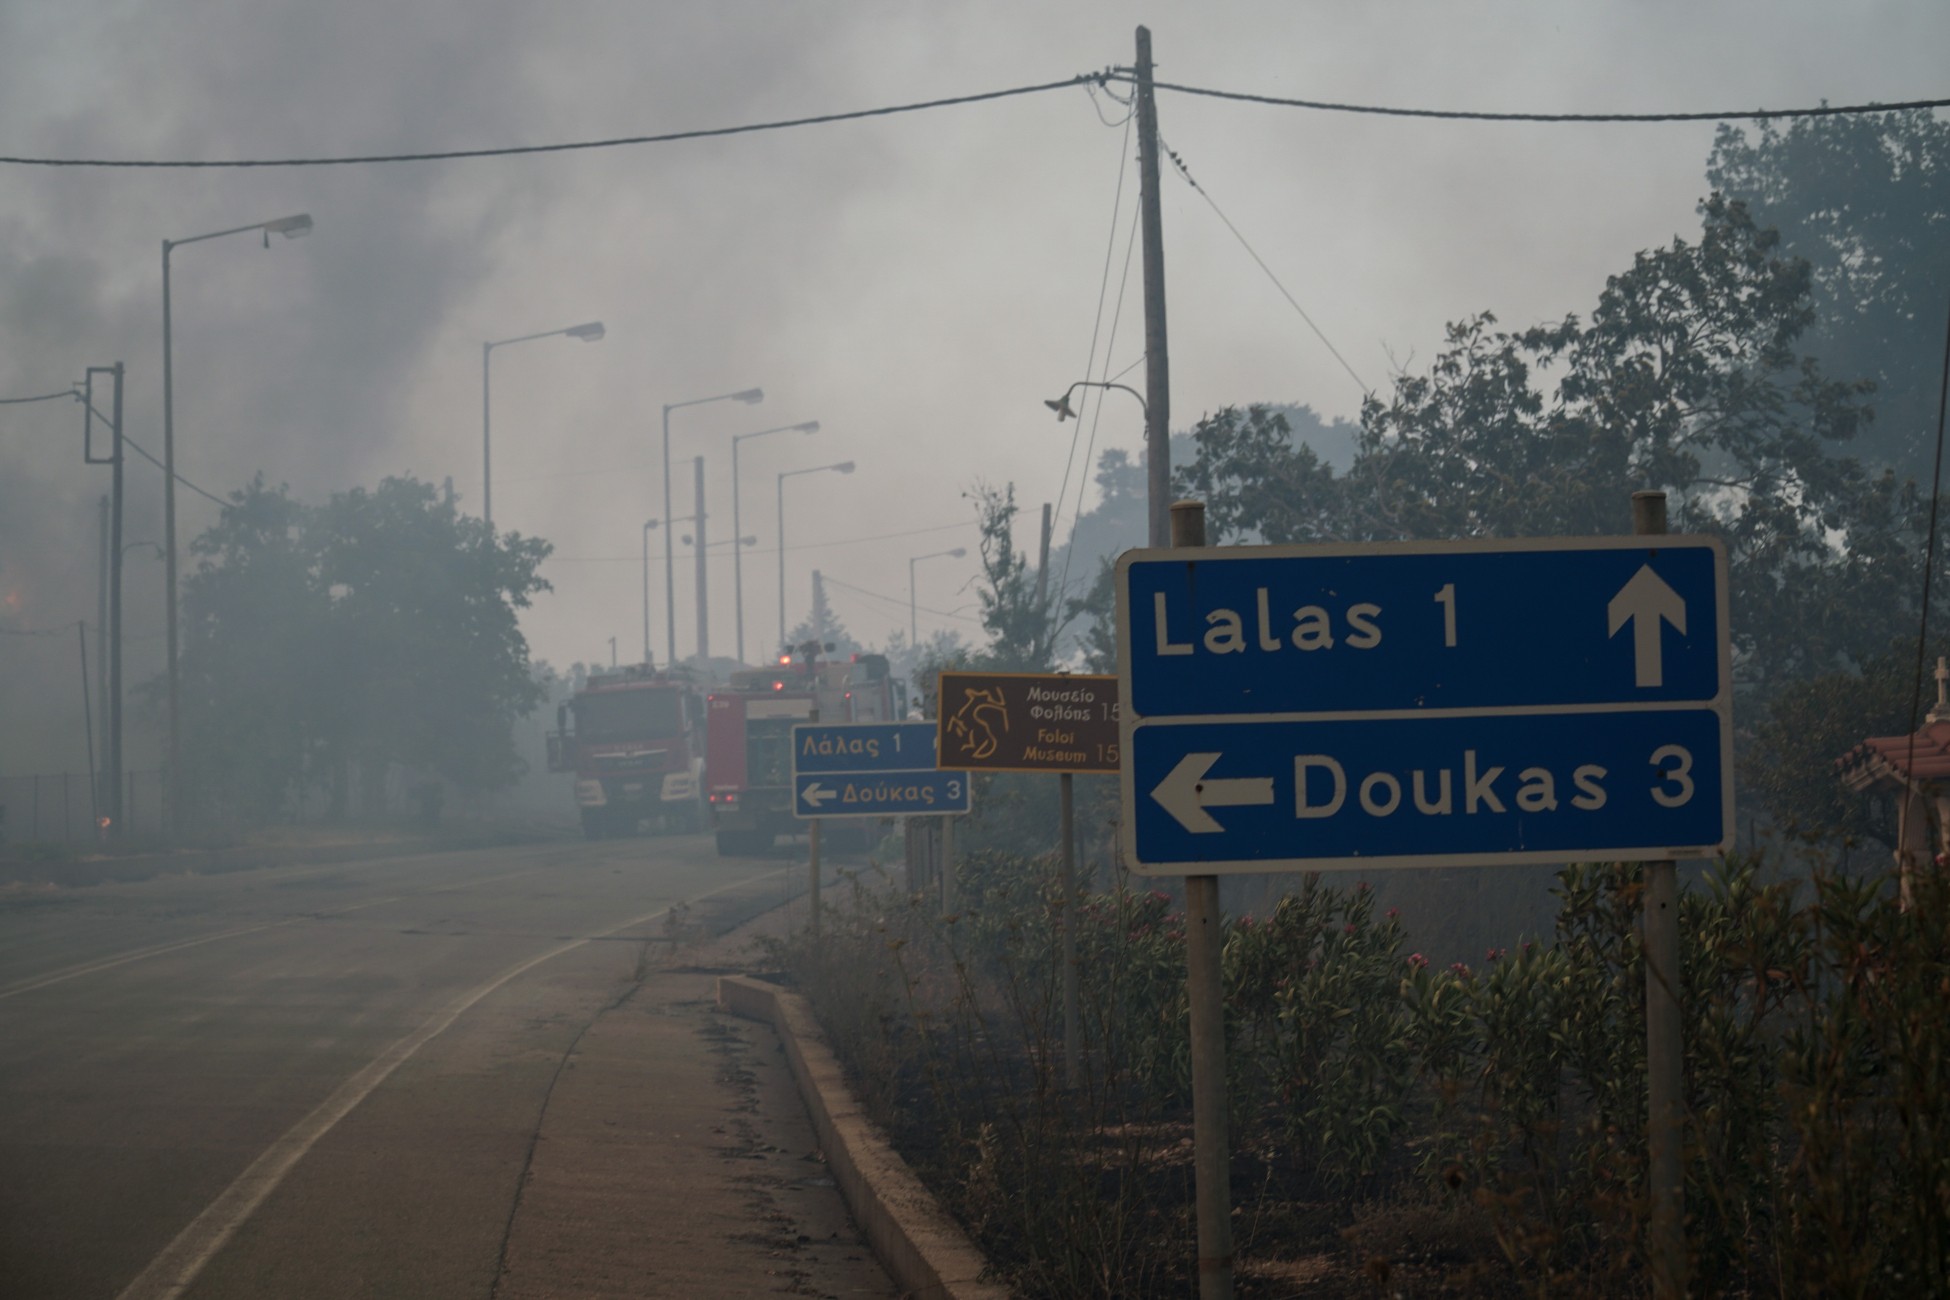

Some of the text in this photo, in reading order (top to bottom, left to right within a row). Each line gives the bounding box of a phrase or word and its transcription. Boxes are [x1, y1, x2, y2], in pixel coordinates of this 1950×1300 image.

[1154, 583, 1457, 656] Lalas 1
[1026, 687, 1095, 703] Μουσείο
[1030, 705, 1091, 722] Φολόης
[803, 733, 900, 758] Λάλας 1
[1038, 728, 1074, 744] Foloi
[1023, 746, 1087, 763] Museum
[1294, 744, 1695, 818] Doukas 3
[842, 780, 961, 804] Δούκας 3
